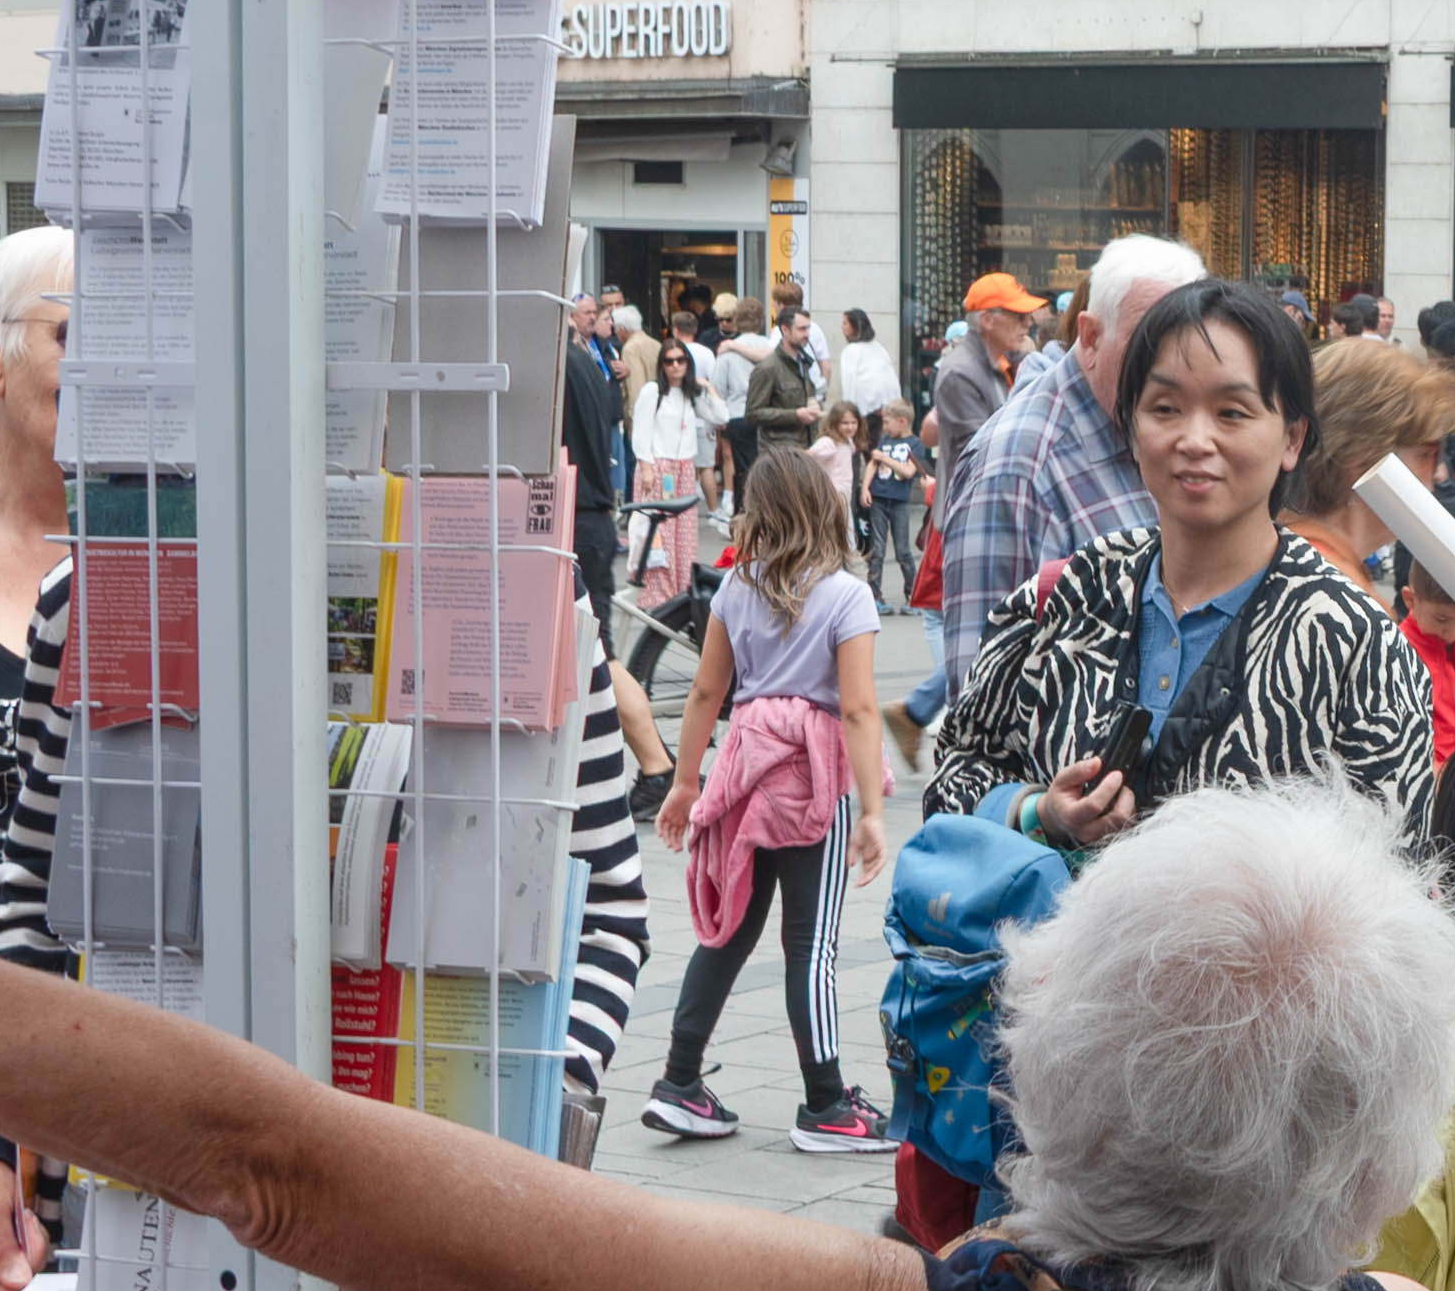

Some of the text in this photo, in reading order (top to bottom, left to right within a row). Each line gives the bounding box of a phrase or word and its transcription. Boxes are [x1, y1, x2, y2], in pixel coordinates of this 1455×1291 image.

[573, 0, 729, 60] SUPERFOOD
[531, 492, 554, 501] mal
[528, 517, 551, 531] FRAU
